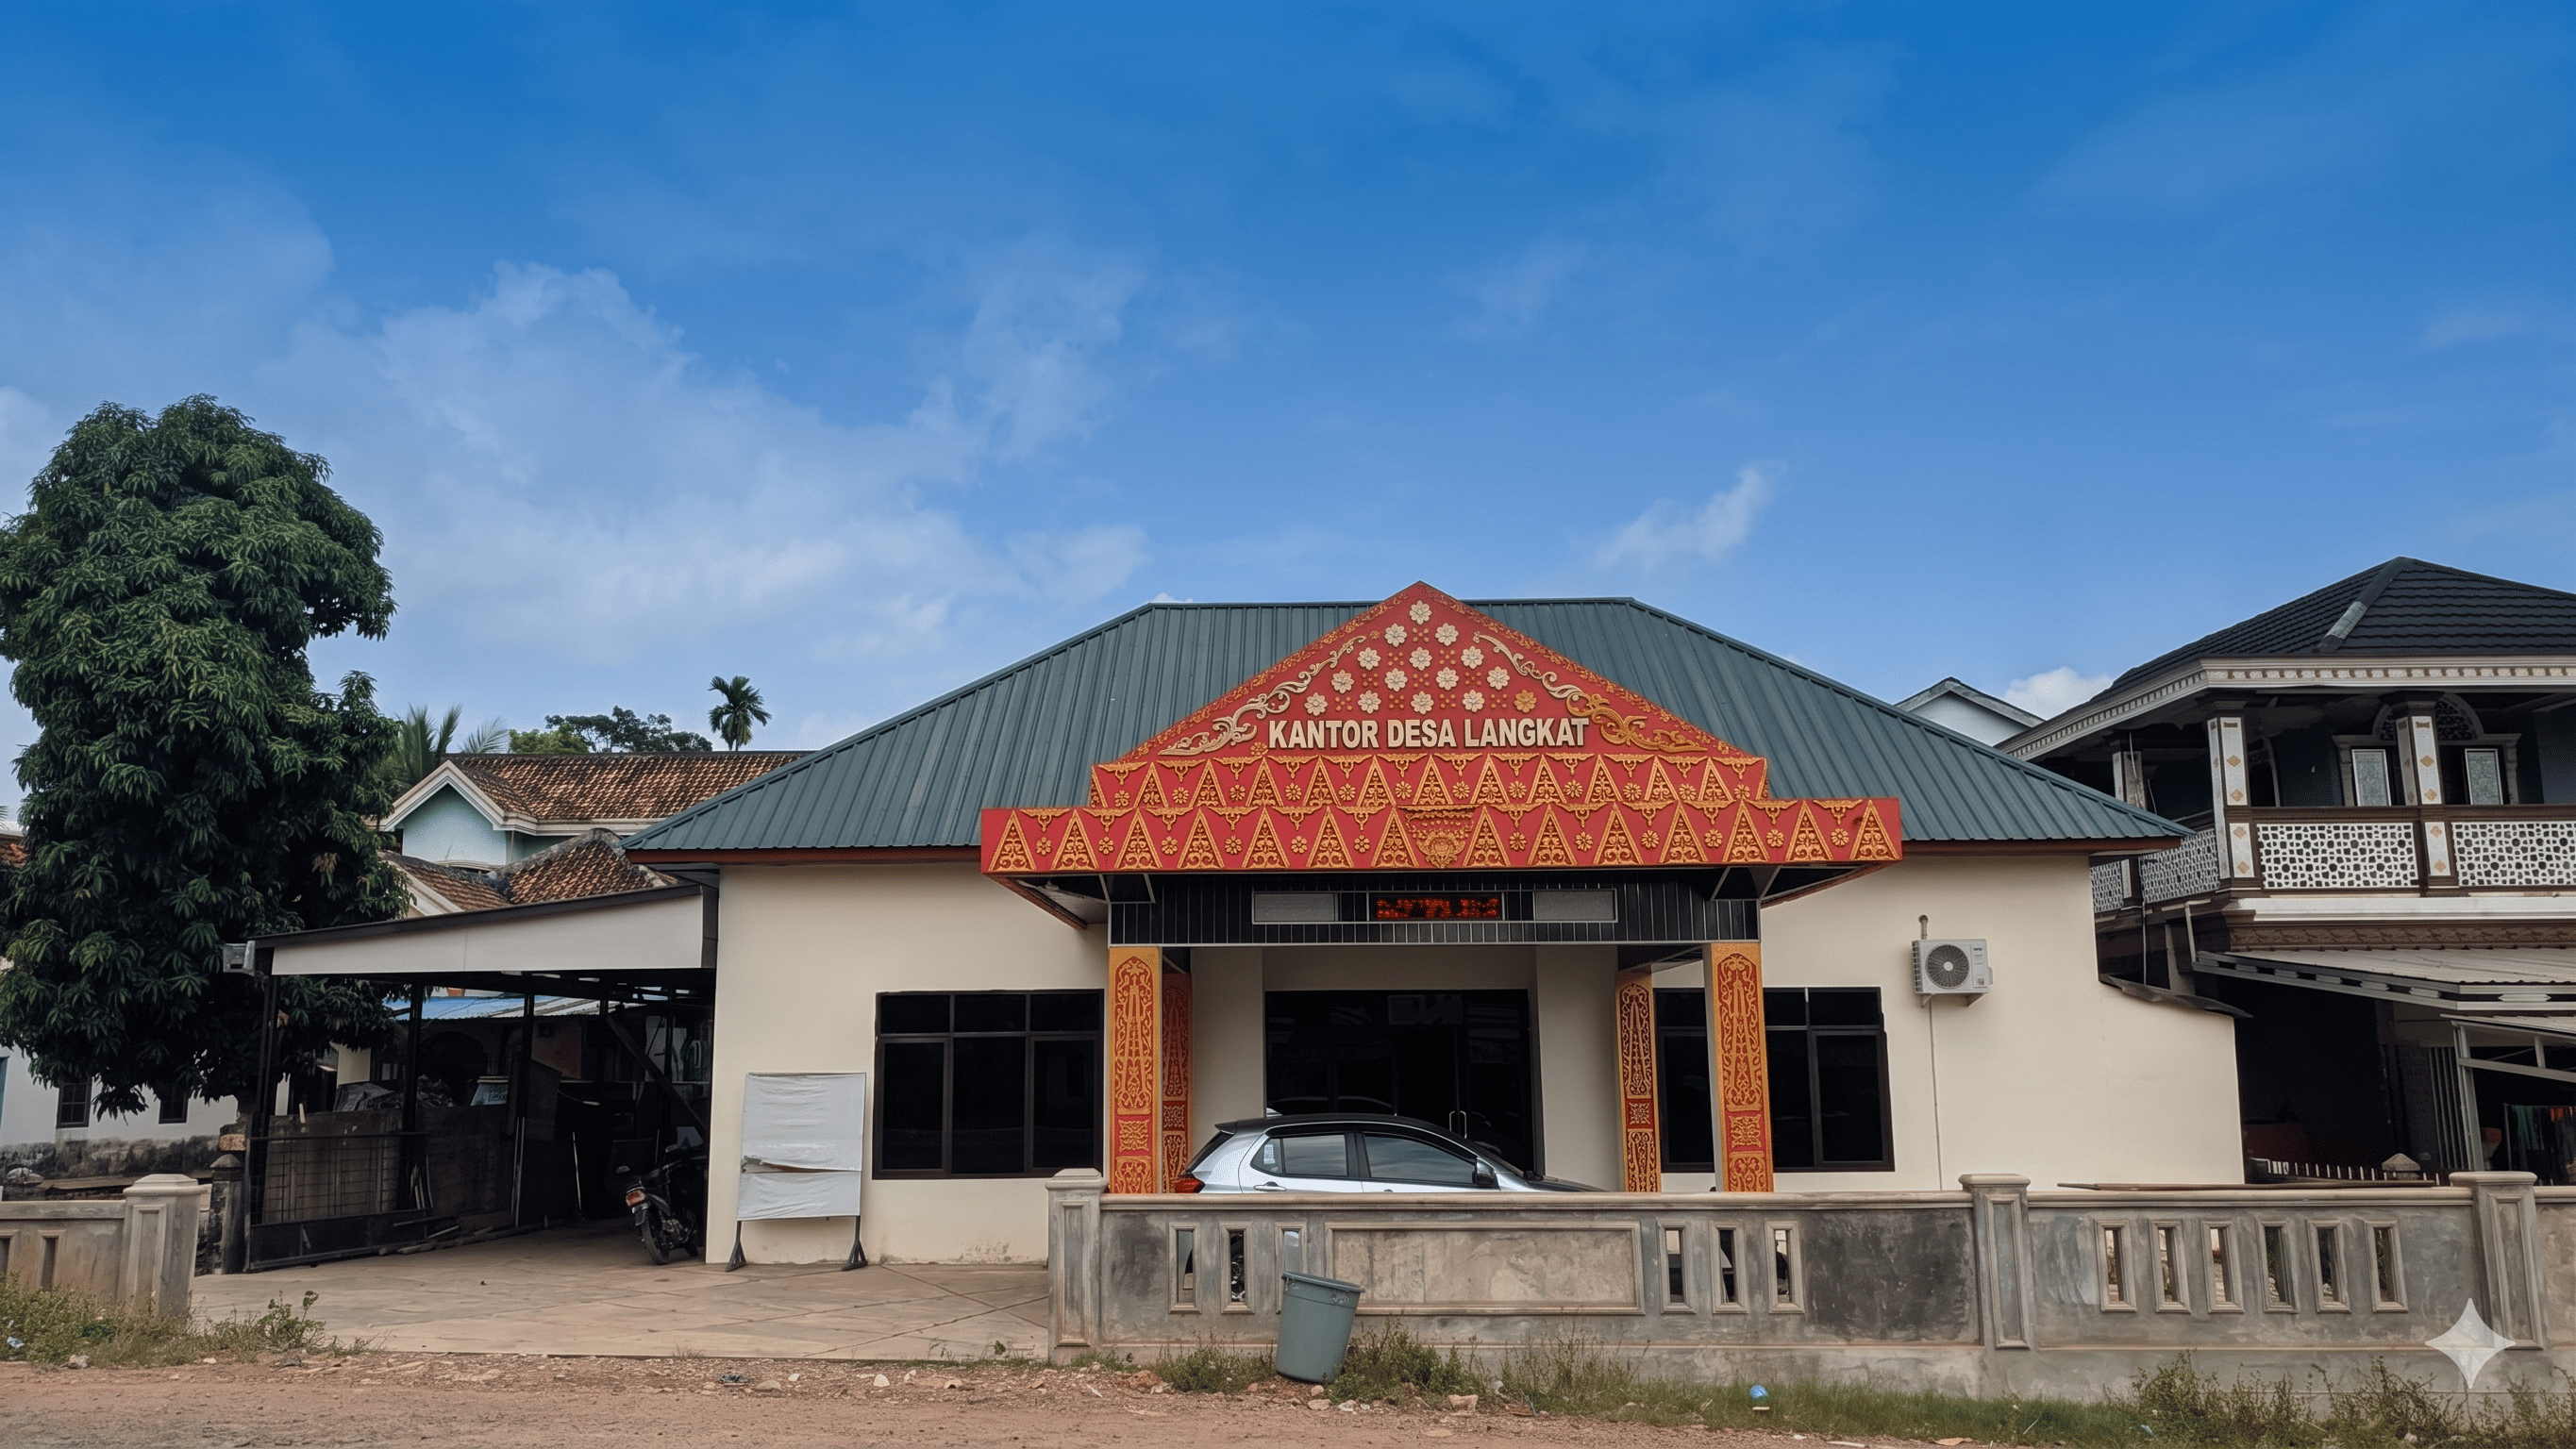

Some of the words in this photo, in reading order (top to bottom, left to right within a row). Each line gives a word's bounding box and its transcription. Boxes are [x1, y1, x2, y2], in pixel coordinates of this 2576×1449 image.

[1268, 719, 1380, 749] KANTOR
[1387, 719, 1457, 747] DESA
[1464, 718, 1589, 747] LANGKAT
